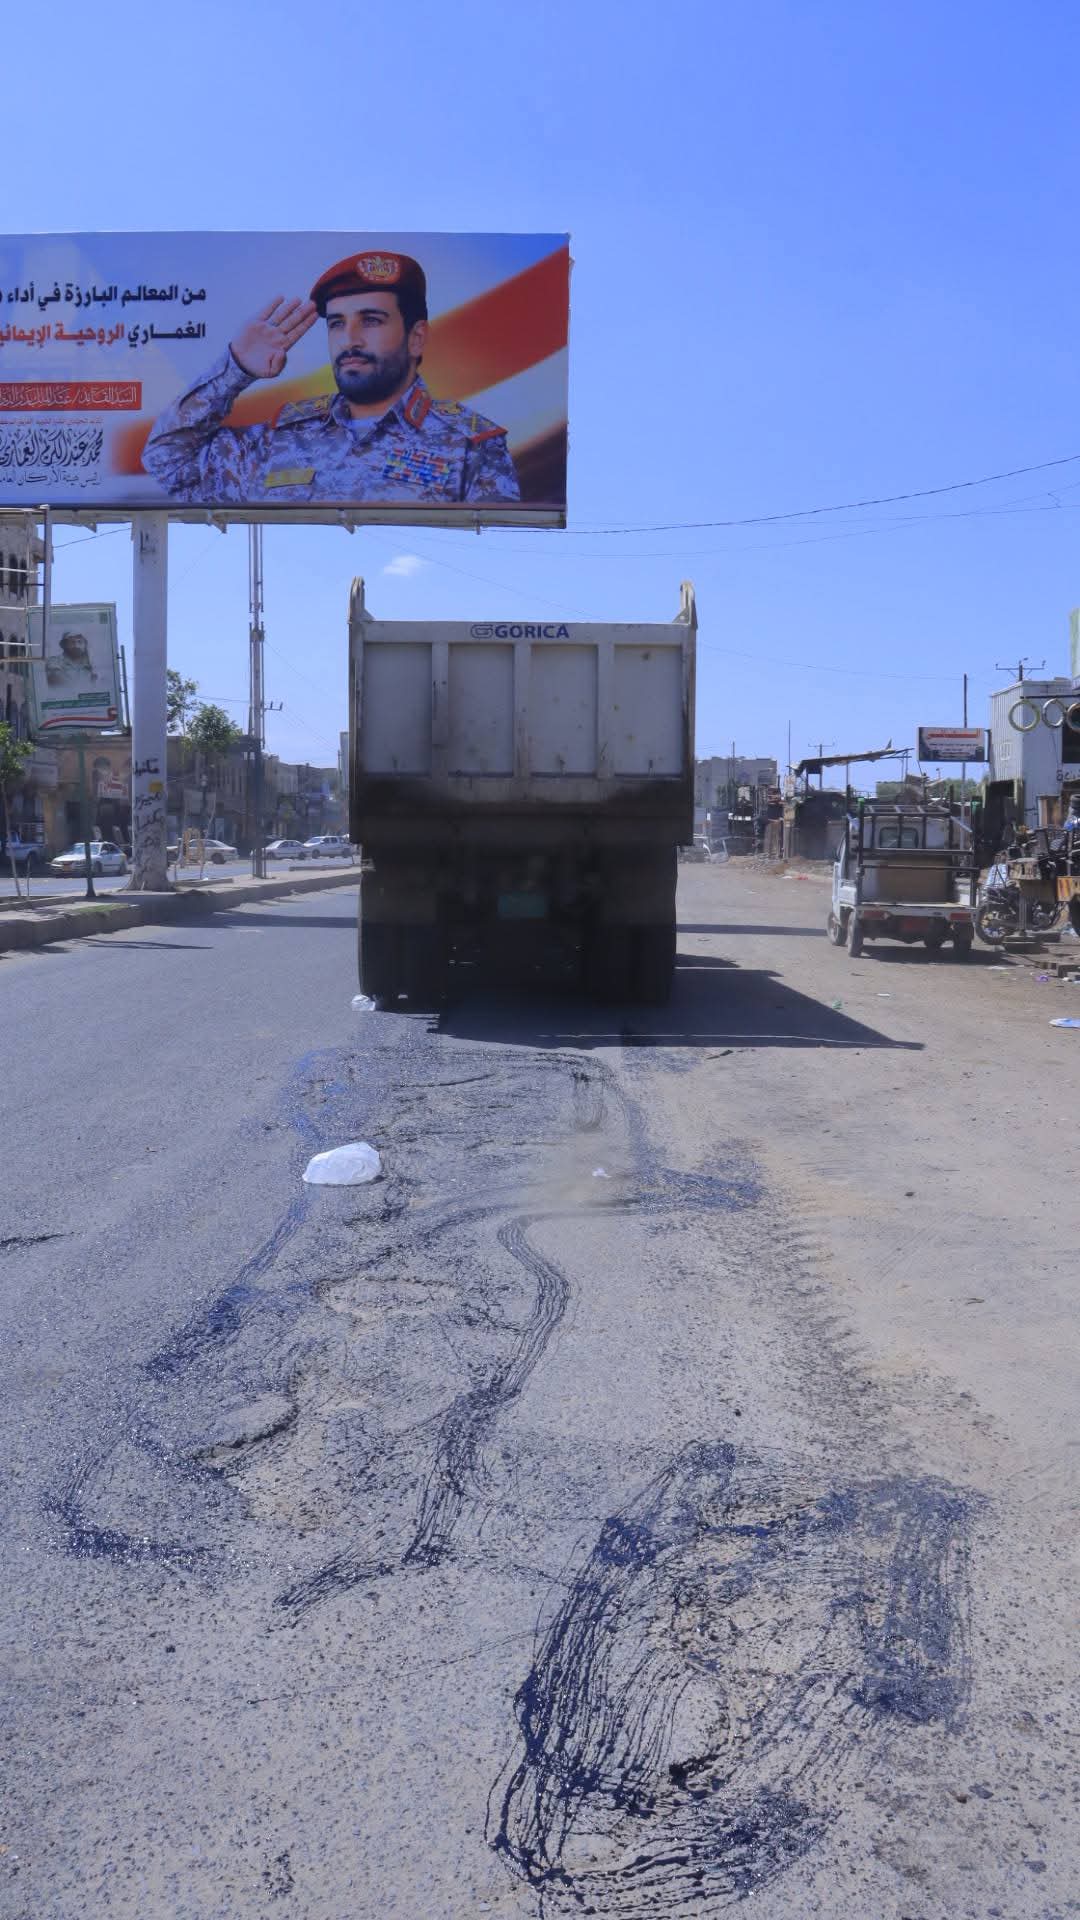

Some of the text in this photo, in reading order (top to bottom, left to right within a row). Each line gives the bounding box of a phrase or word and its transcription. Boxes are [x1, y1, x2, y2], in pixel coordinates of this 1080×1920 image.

[7, 281, 206, 311] من المعالم البارزة في أداء
[0, 323, 51, 349] الإيماني
[54, 320, 125, 346] الروحية
[495, 624, 569, 639] GORICA
